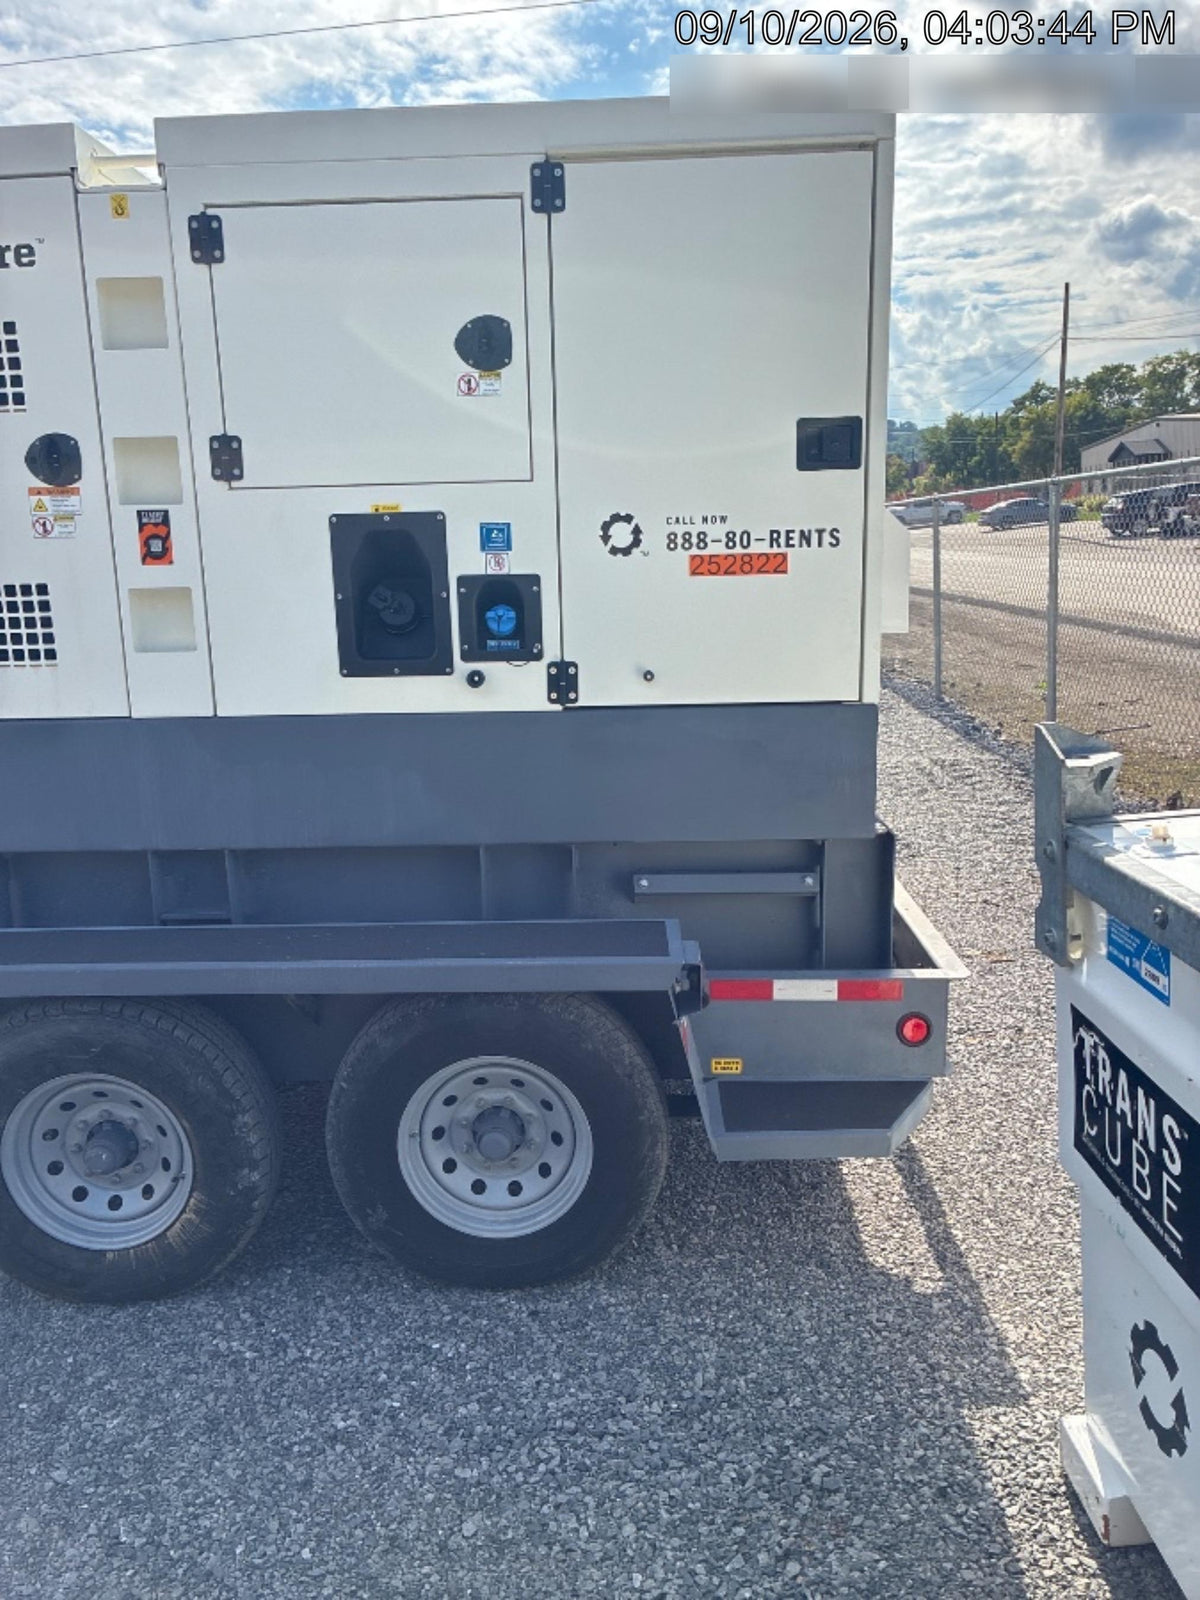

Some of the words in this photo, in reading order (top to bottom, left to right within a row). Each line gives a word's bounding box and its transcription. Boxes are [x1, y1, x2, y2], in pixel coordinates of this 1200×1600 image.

[666, 516, 696, 525] CALL
[701, 515, 728, 525] NOW
[666, 528, 841, 551] 888-80-RENTS
[691, 553, 788, 575] 252822
[1079, 1025, 1183, 1177] TRANS
[1082, 1083, 1184, 1243] CUBE
